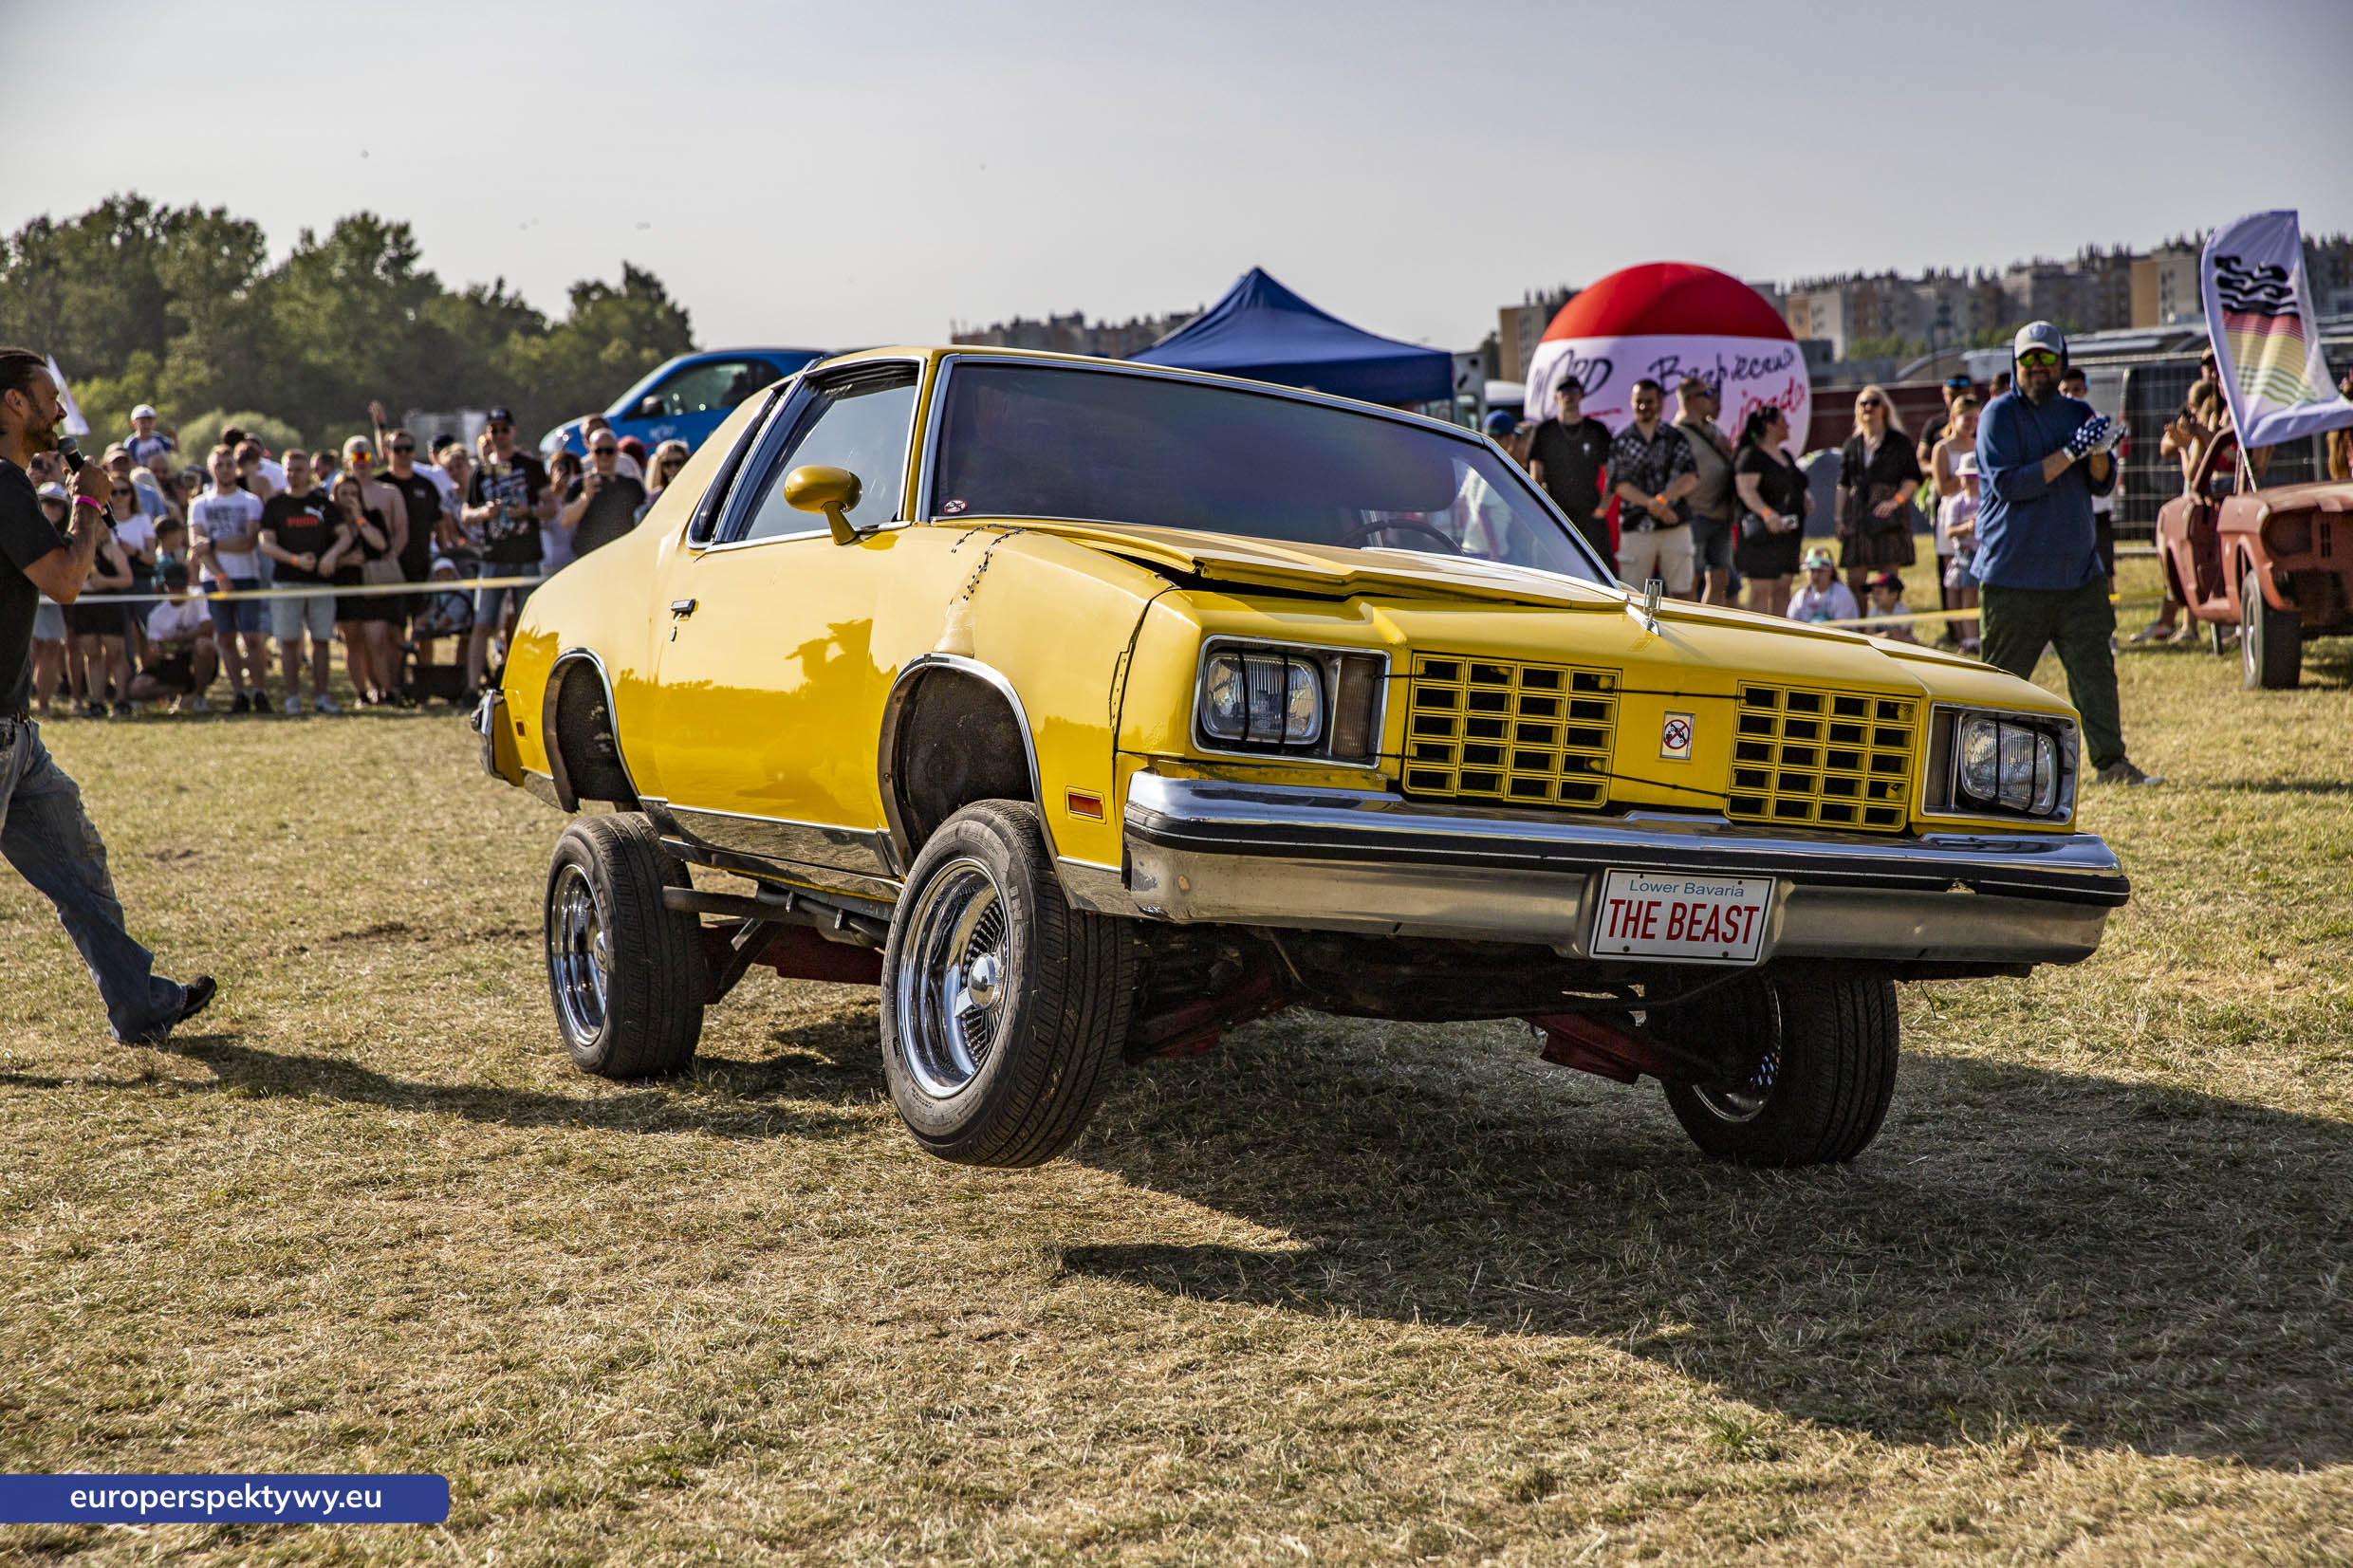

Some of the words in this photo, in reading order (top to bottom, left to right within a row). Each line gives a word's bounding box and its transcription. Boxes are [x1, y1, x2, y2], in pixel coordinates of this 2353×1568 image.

[1629, 879, 1678, 894] Lower
[1683, 882, 1745, 897] Bavaria
[1608, 898, 1662, 940] THE
[1666, 901, 1761, 945] BEAST
